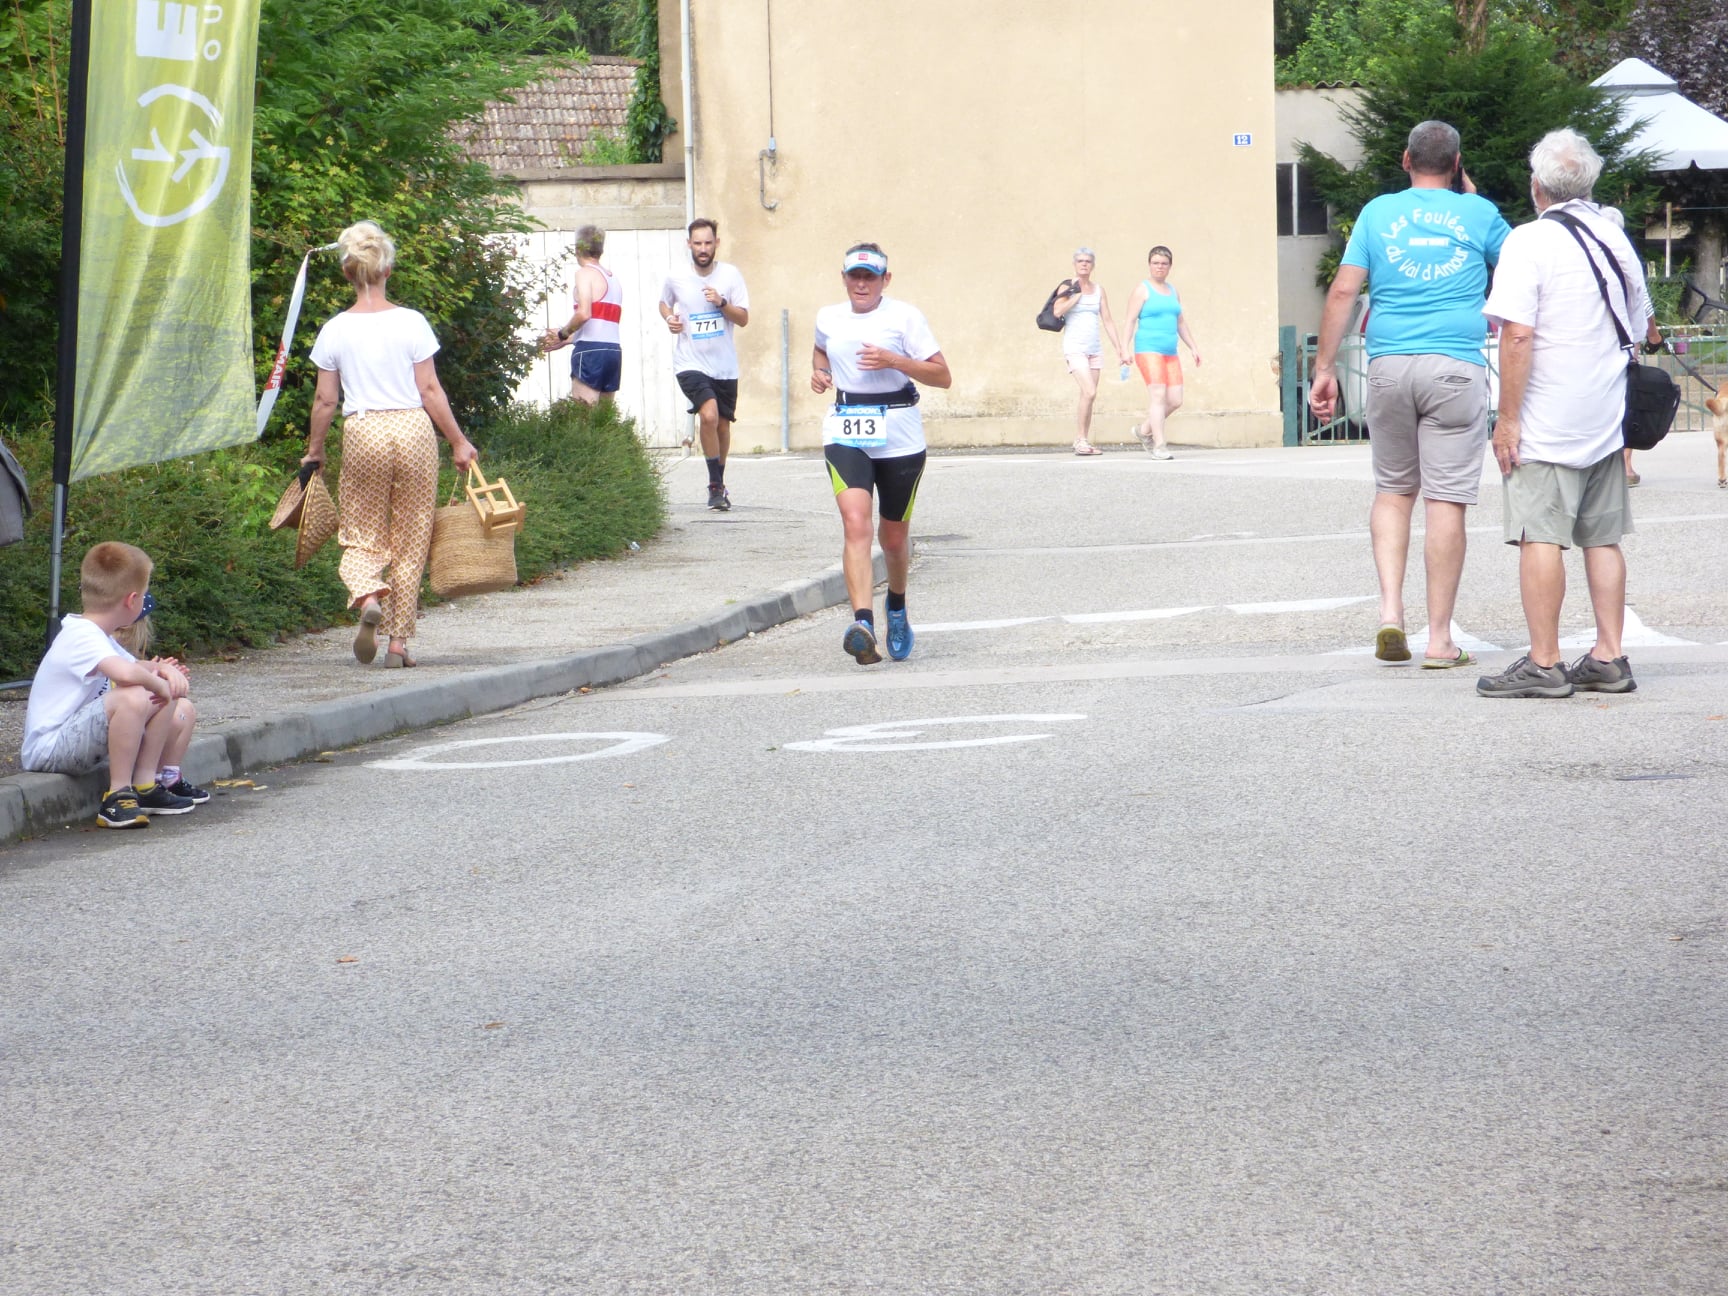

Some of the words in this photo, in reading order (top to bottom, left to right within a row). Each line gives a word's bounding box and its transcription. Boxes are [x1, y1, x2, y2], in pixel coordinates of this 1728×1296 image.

[1381, 215, 1408, 239] Les
[1412, 208, 1469, 241] Foulées
[1386, 246, 1406, 263] du
[1398, 258, 1421, 279] Val
[695, 320, 717, 332] 771
[270, 351, 287, 388] MAIF
[843, 419, 876, 435] 813
